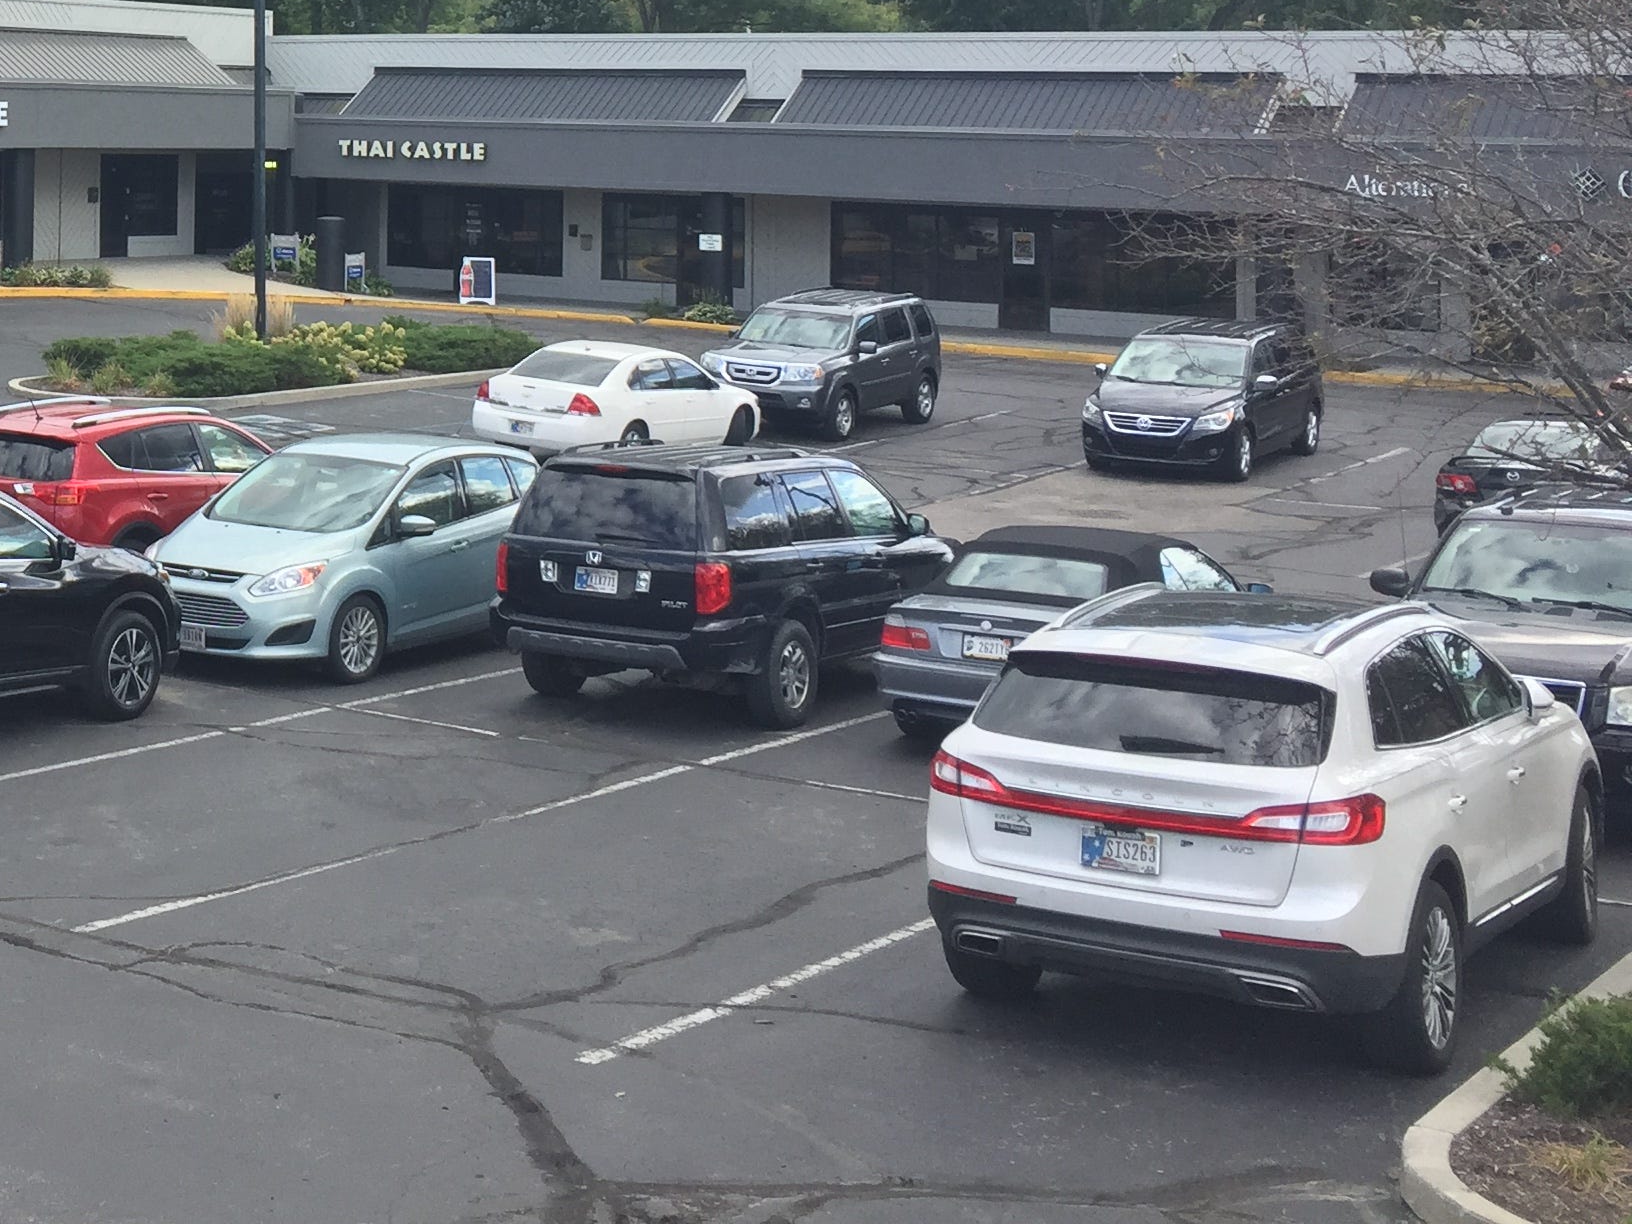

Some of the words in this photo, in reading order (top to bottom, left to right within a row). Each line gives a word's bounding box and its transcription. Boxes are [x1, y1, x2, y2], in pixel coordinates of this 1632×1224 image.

[338, 139, 394, 158] THAI
[400, 141, 485, 161] CASTLE
[1028, 778, 1214, 808] LINCOLN
[1106, 839, 1156, 863] SIS263
